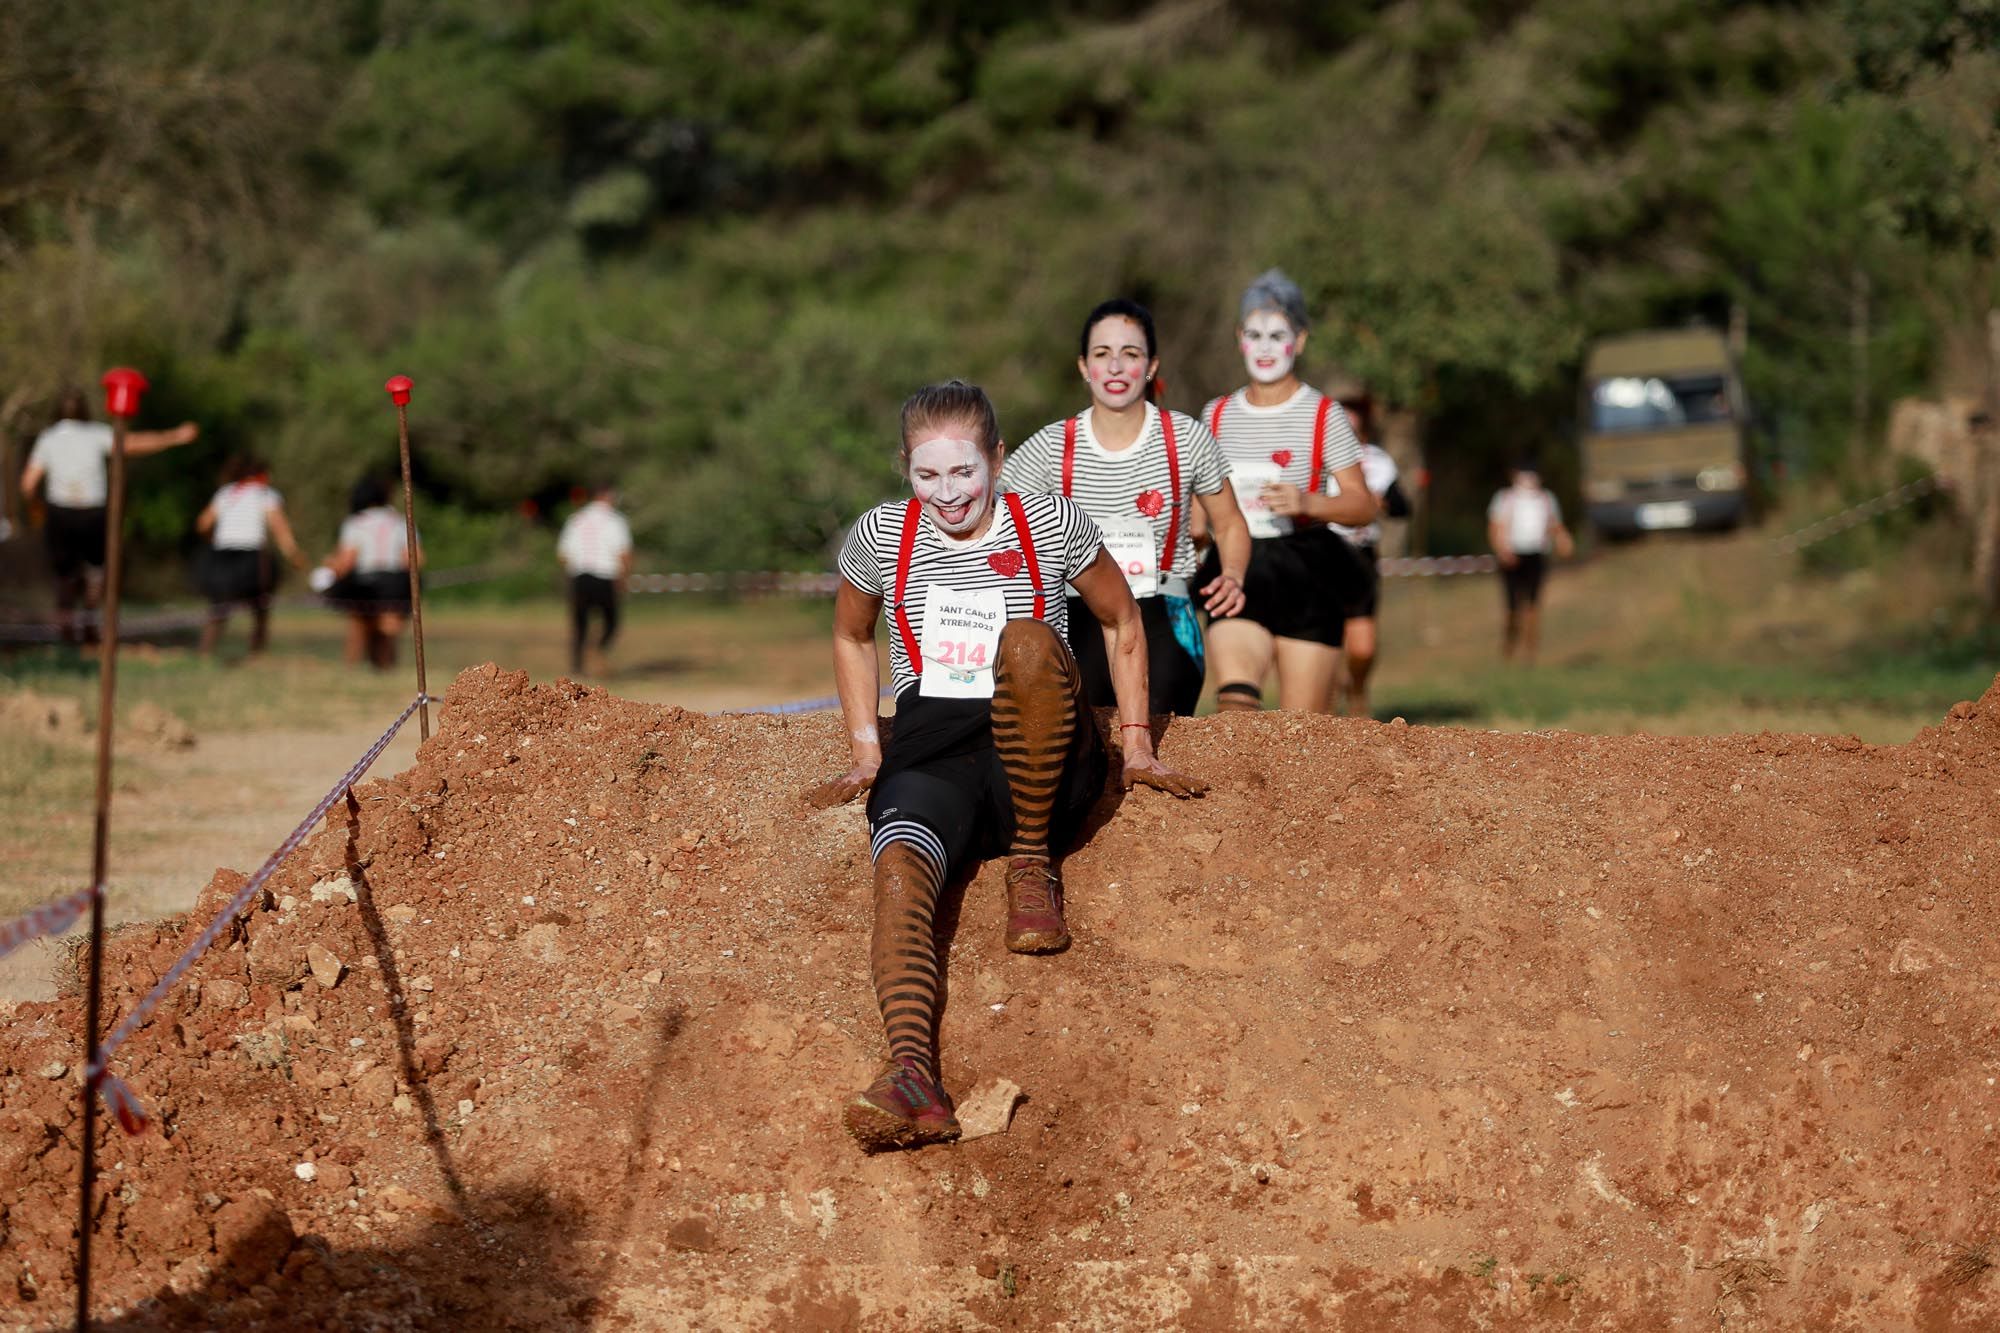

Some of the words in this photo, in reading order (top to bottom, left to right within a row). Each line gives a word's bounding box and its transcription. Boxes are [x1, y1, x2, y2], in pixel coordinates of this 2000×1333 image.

[940, 618, 971, 627] XTREM
[972, 621, 994, 632] 2023
[937, 640, 986, 666] 214
